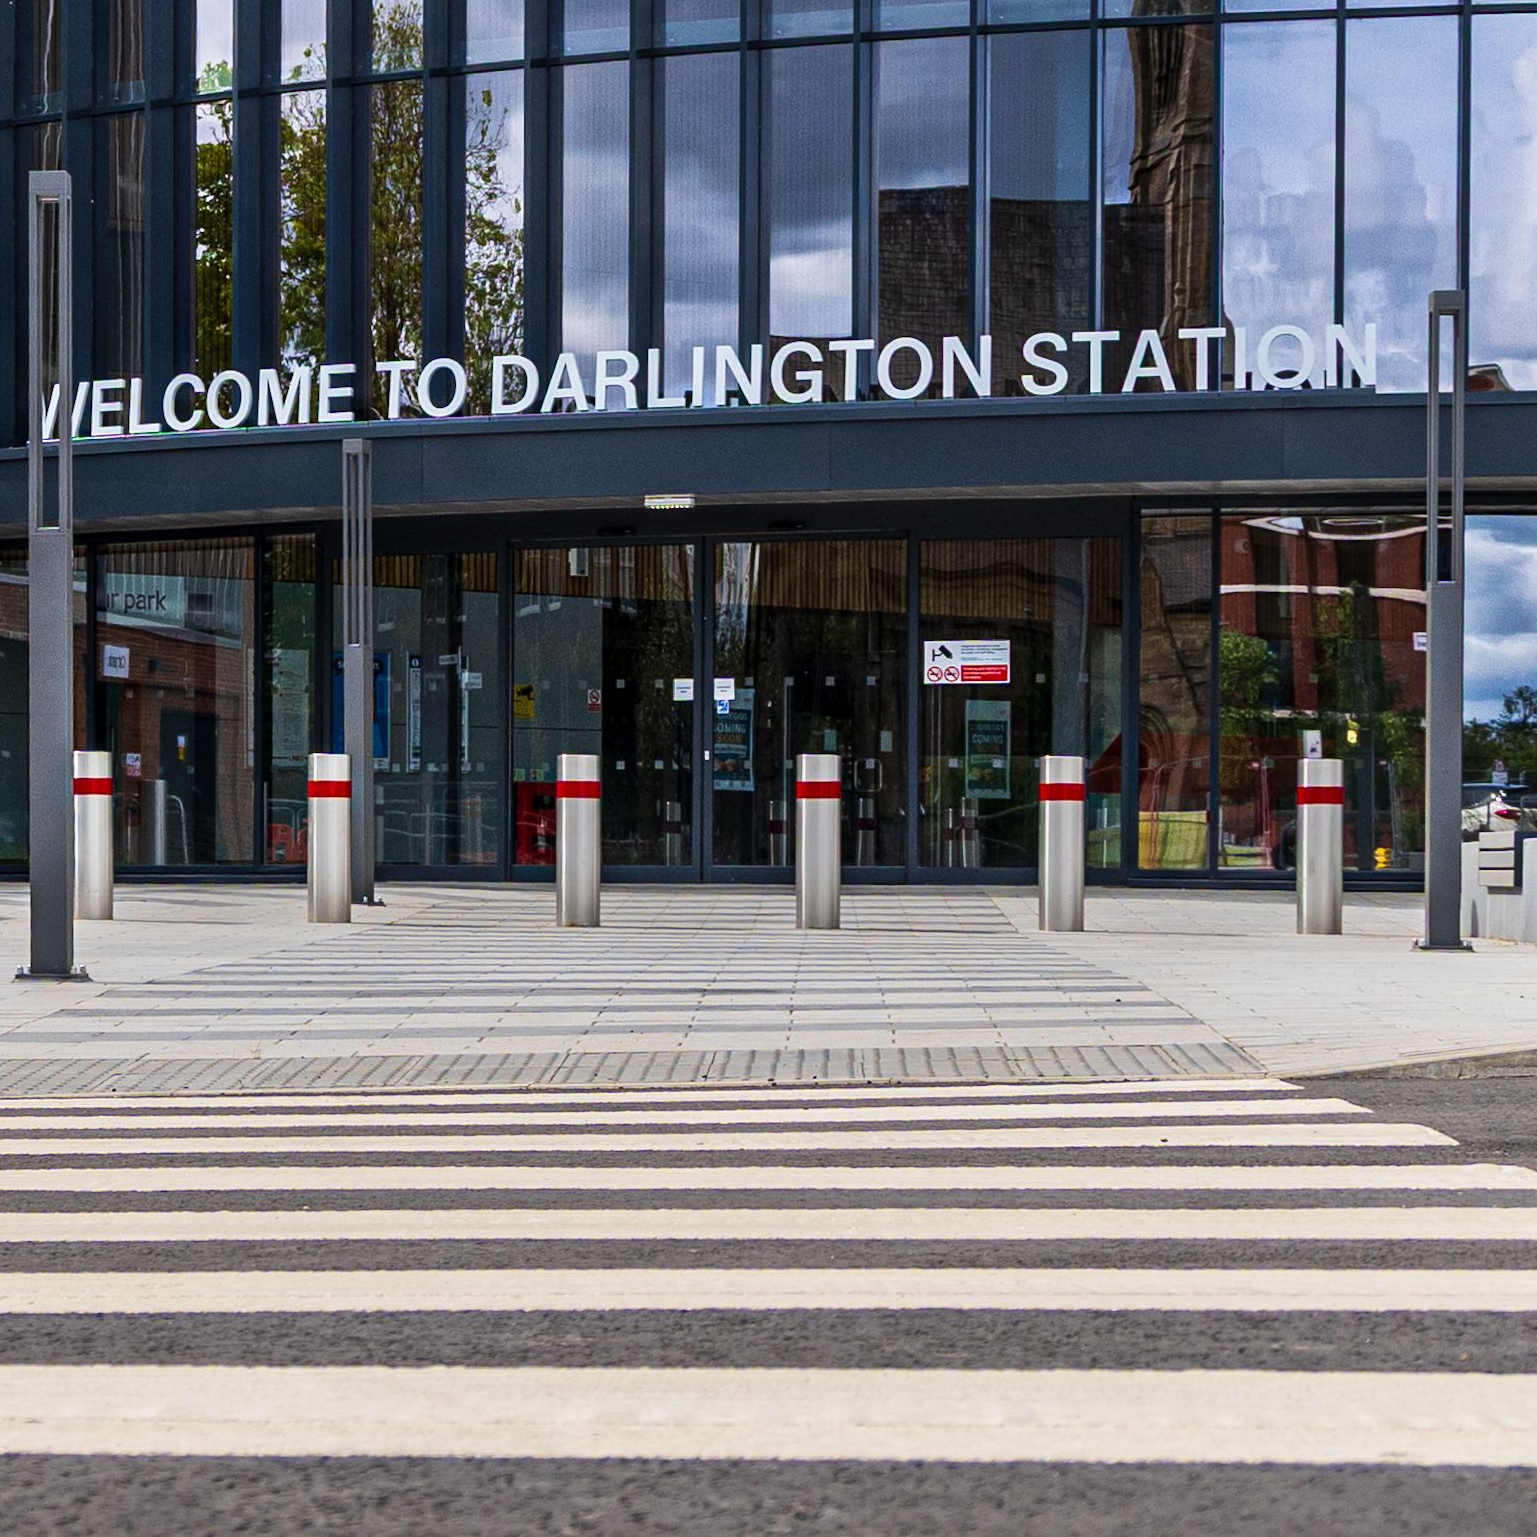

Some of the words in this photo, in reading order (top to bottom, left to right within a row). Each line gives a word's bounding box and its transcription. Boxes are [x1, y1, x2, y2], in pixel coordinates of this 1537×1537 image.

[375, 358, 468, 419] TO
[491, 335, 992, 415] DARLINGTON
[1021, 323, 1377, 396] STATION
[124, 589, 167, 614] park
